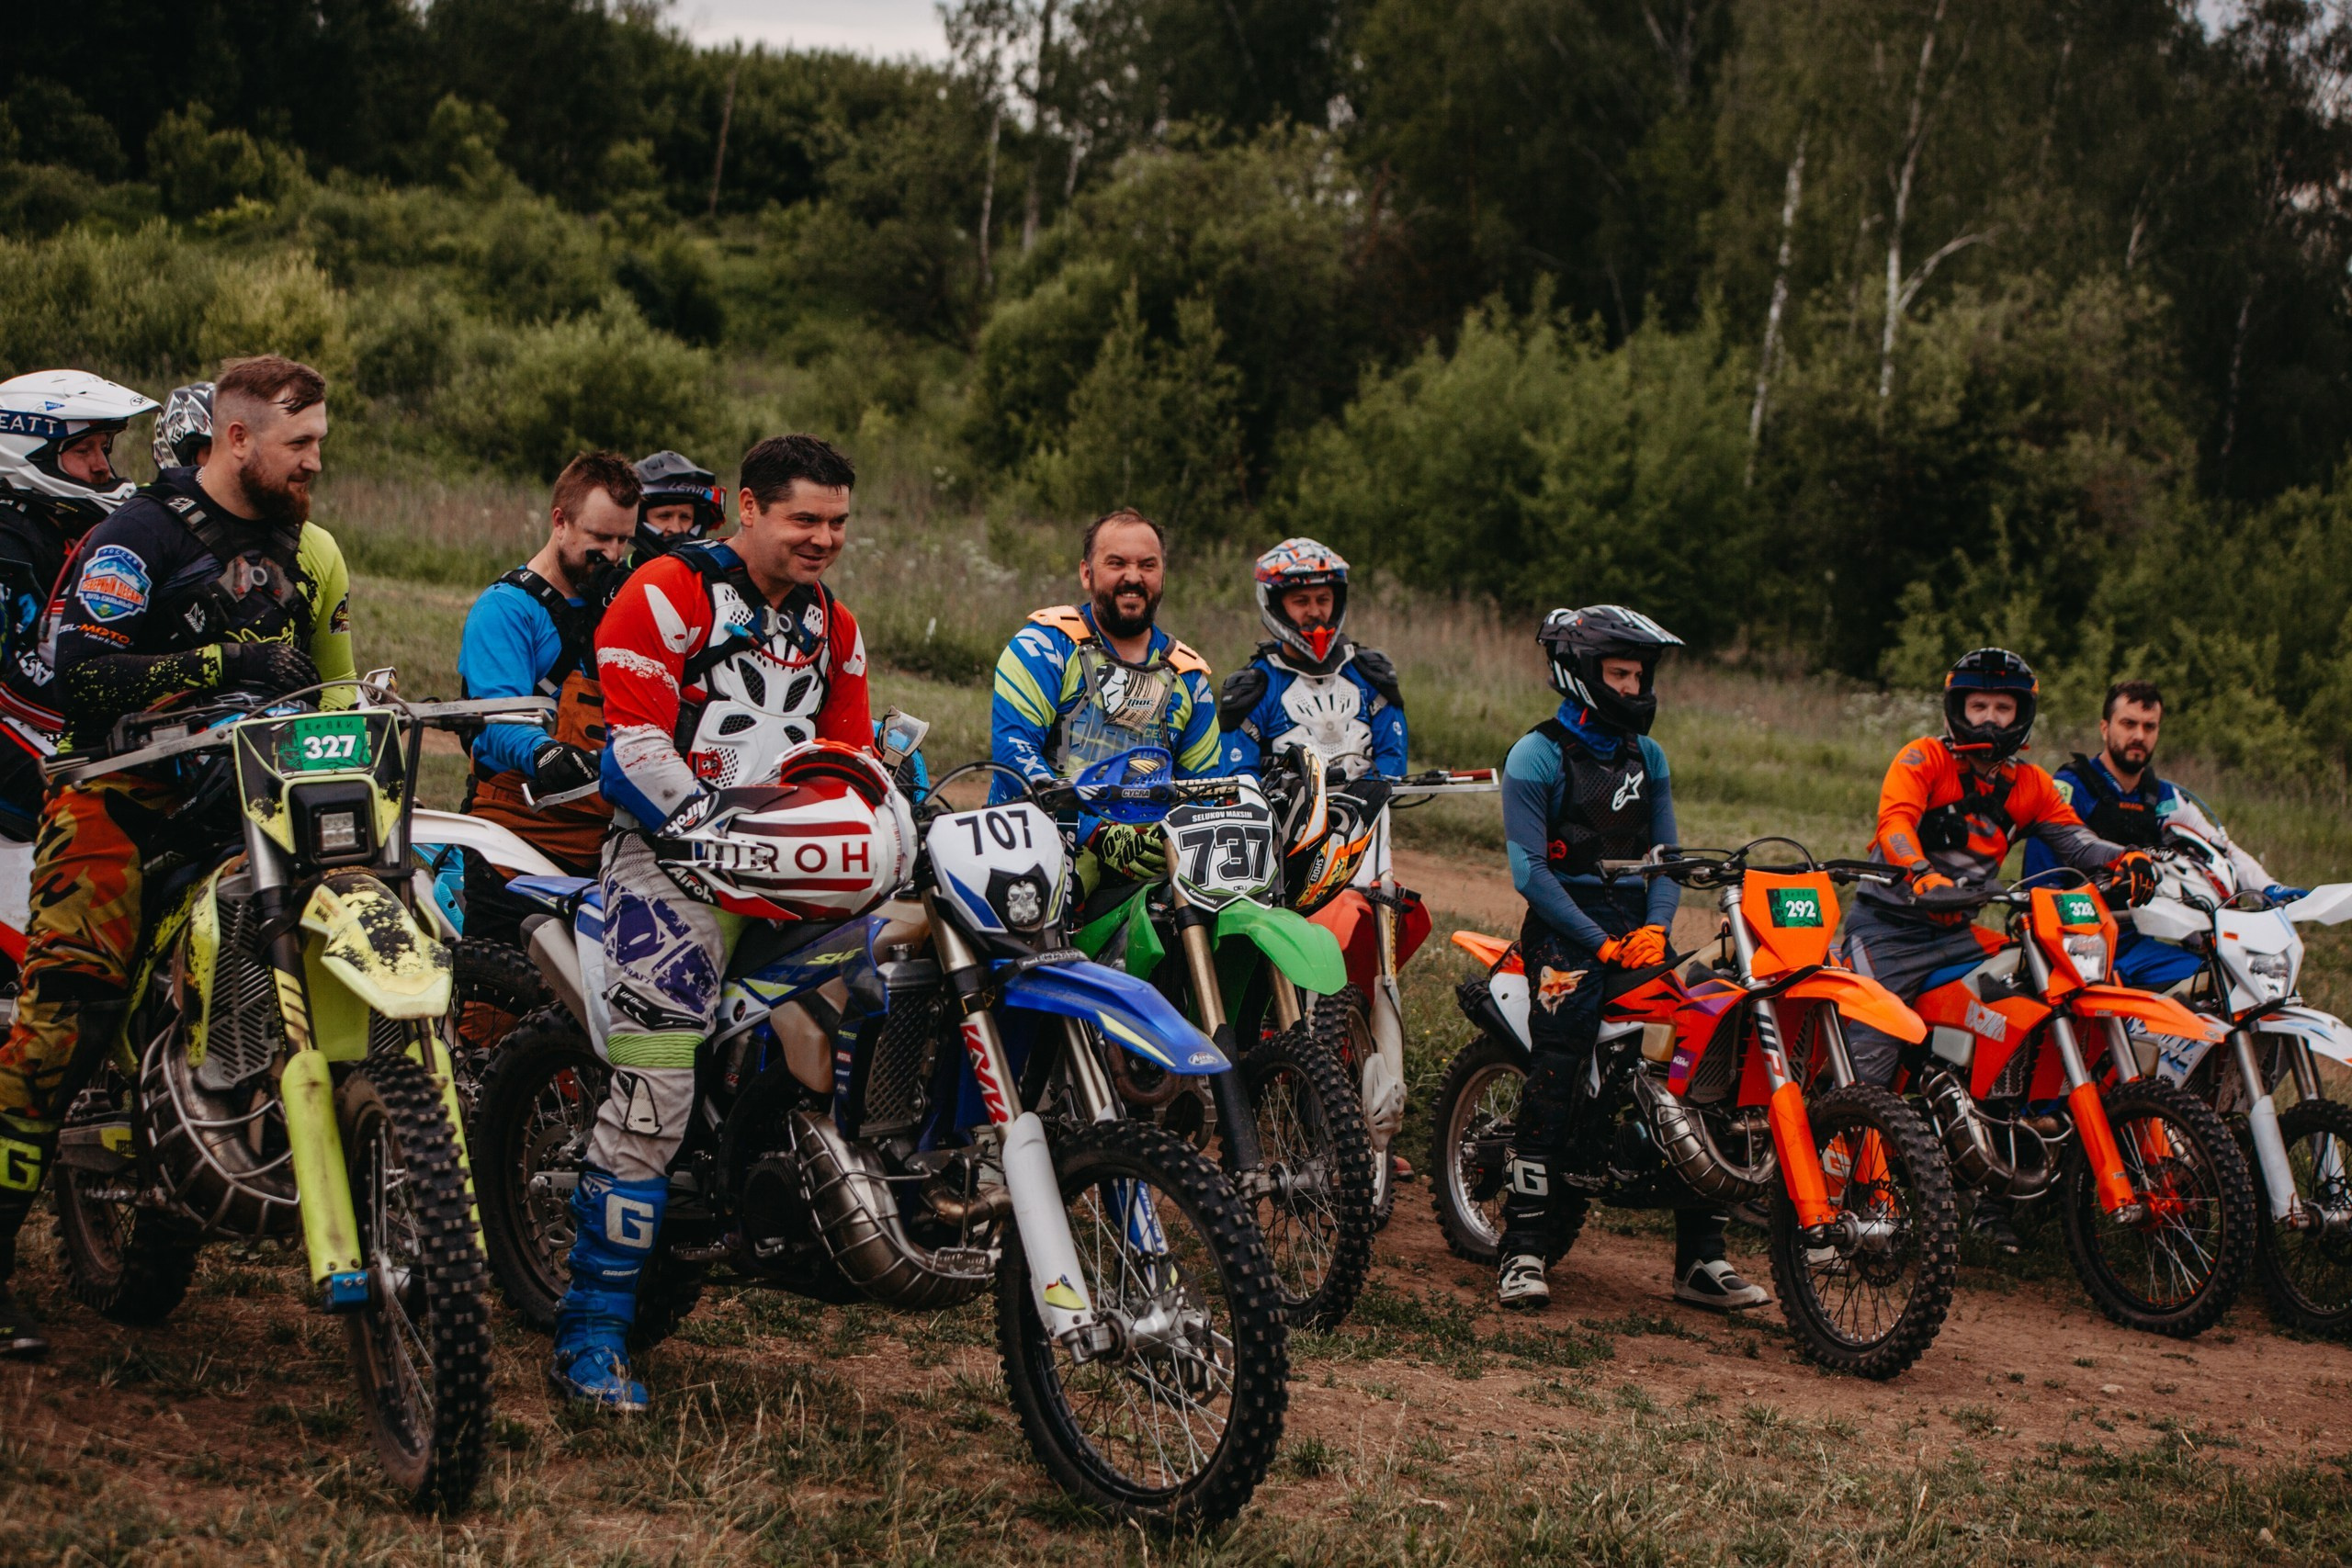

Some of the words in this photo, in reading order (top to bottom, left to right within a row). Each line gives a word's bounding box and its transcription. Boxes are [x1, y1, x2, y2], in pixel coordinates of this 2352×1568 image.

[303, 735, 356, 760] 327
[1122, 789, 1150, 798] CYCRA
[665, 795, 711, 835] Airoh
[1192, 812, 1225, 822] SELUKOV
[955, 810, 1032, 856] 707
[1179, 824, 1272, 888] 737
[1309, 858, 1324, 882] SHOEI
[667, 865, 715, 904] Airoh
[1188, 888, 1218, 906] Kawasaki
[1785, 900, 1816, 917] 292
[619, 992, 640, 1003] UFO
[1672, 1055, 1689, 1067] KTM
[1513, 1158, 1549, 1196] G
[606, 1193, 654, 1249] G
